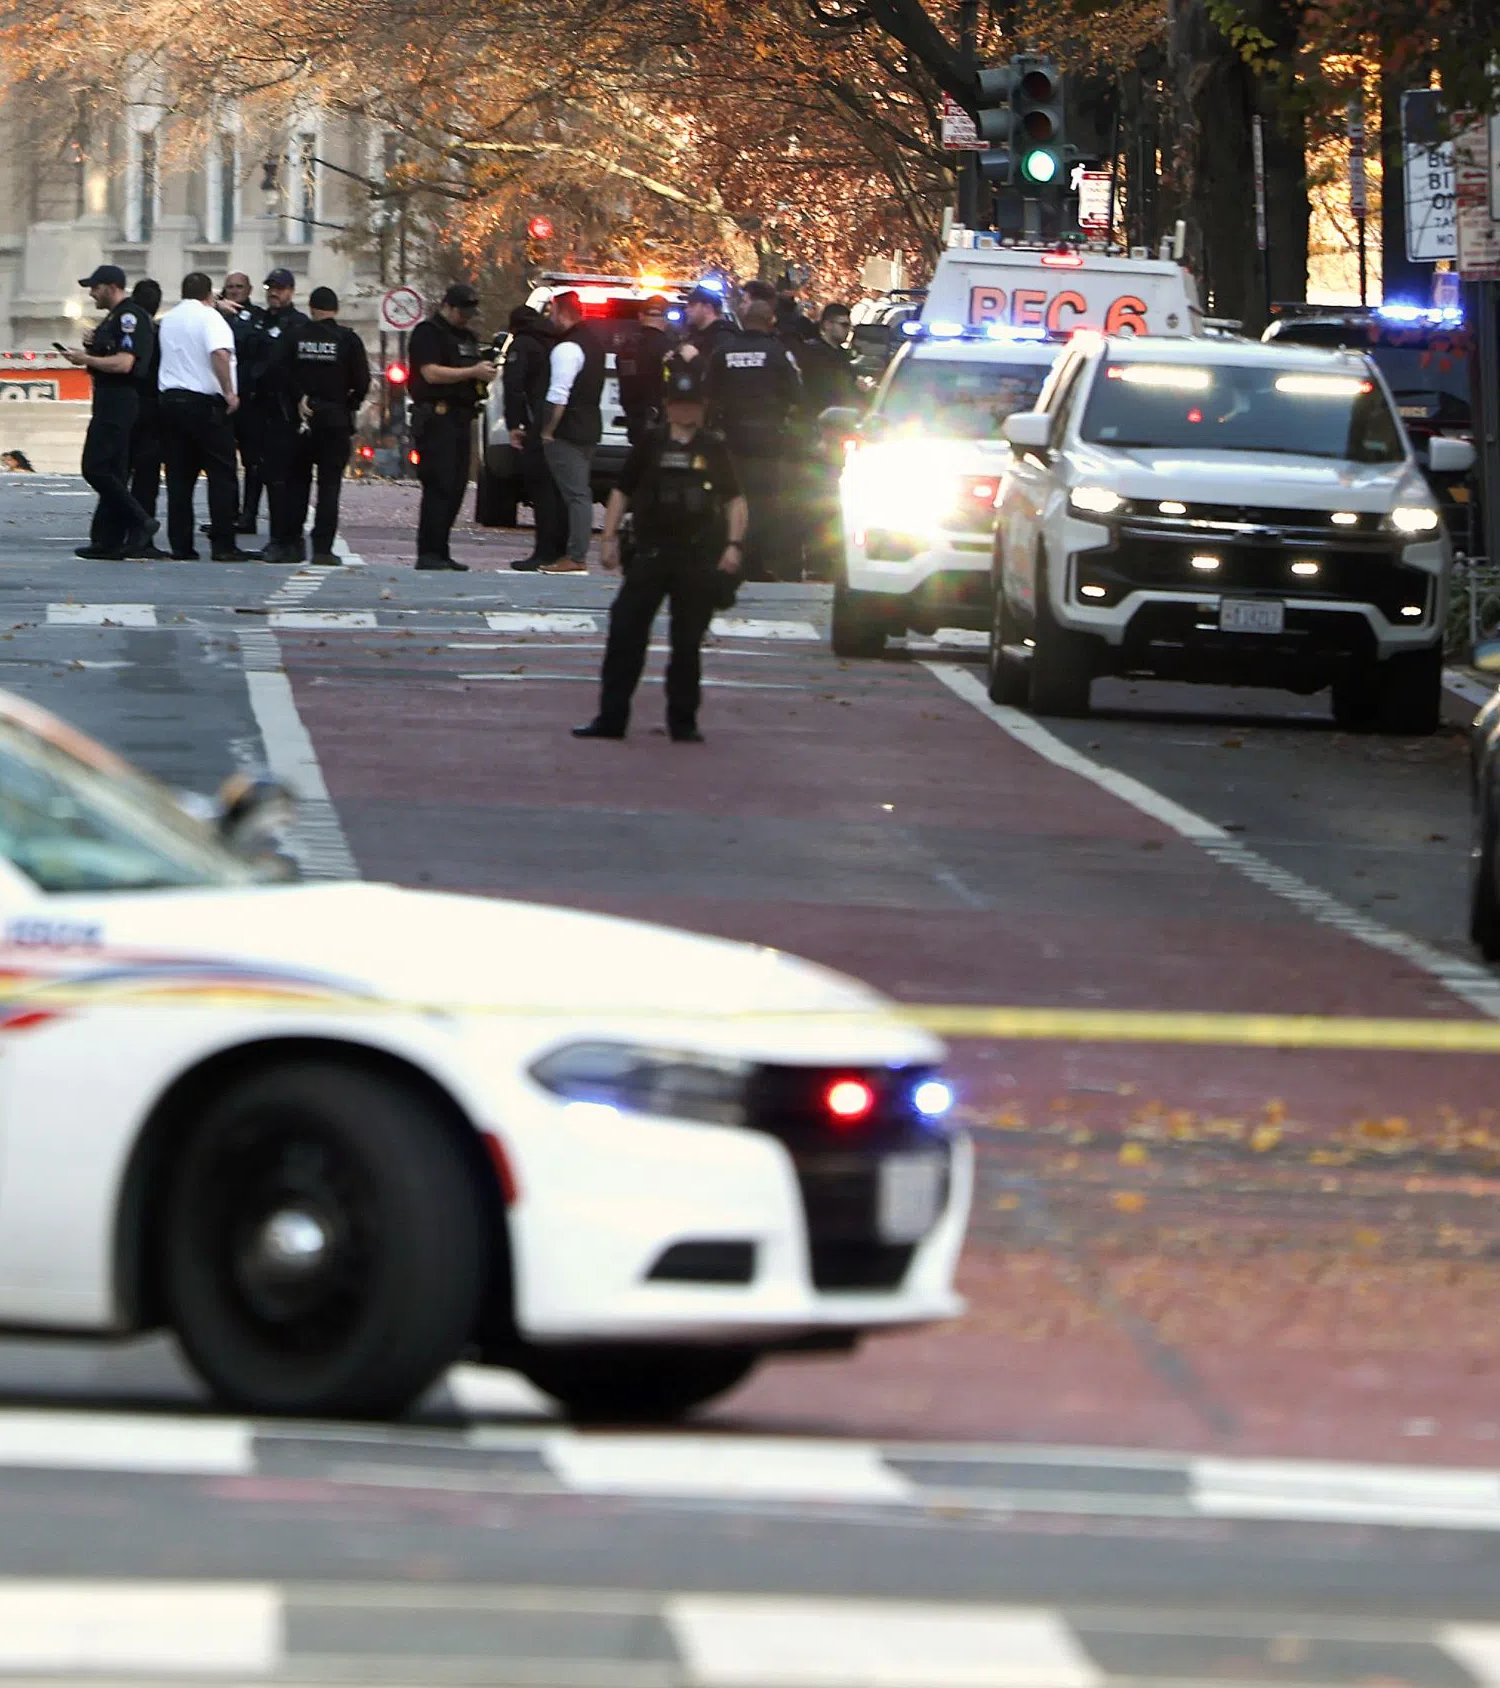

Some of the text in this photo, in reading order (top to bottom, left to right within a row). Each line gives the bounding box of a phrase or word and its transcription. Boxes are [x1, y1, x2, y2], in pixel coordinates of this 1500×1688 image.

[969, 285, 1149, 337] REC 6
[297, 341, 338, 354] POLICE
